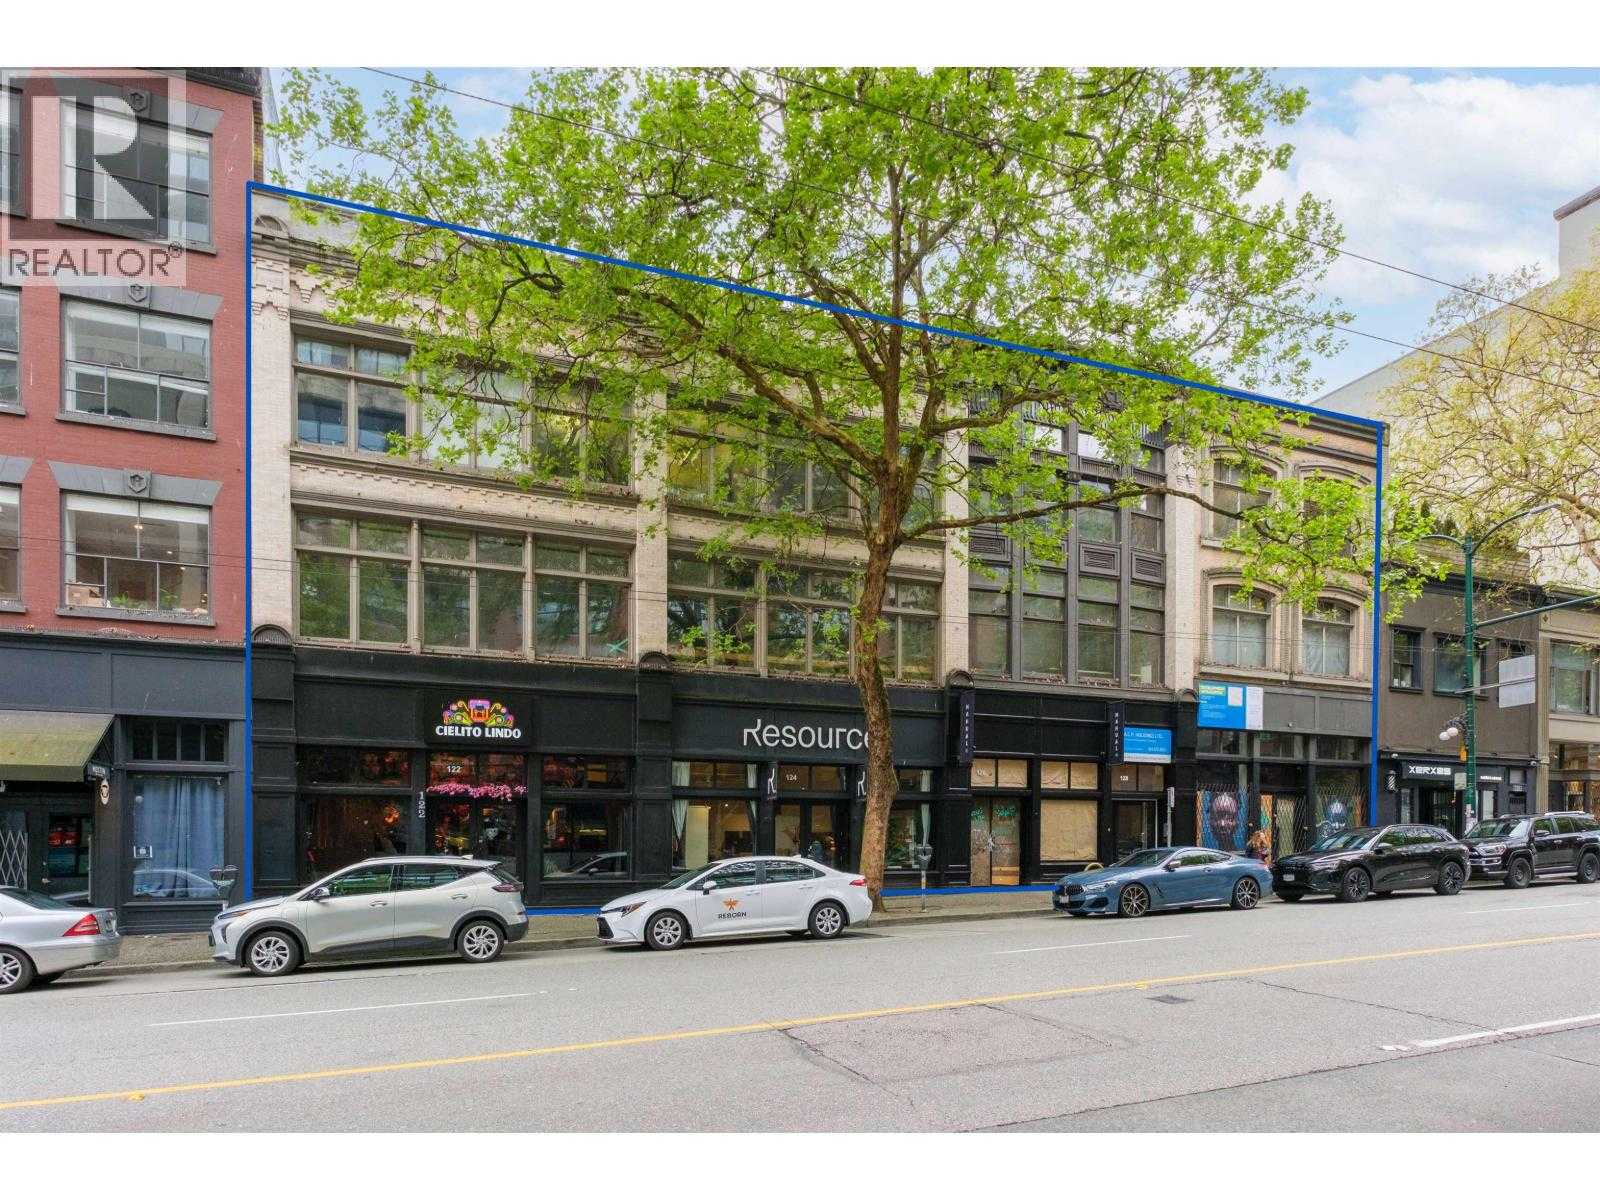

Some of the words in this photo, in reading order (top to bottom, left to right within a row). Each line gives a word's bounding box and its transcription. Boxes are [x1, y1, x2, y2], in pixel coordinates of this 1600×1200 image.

[435, 725, 482, 738] CIELITO
[484, 727, 521, 739] LINDO
[446, 765, 461, 773] 122
[418, 791, 426, 818] 122
